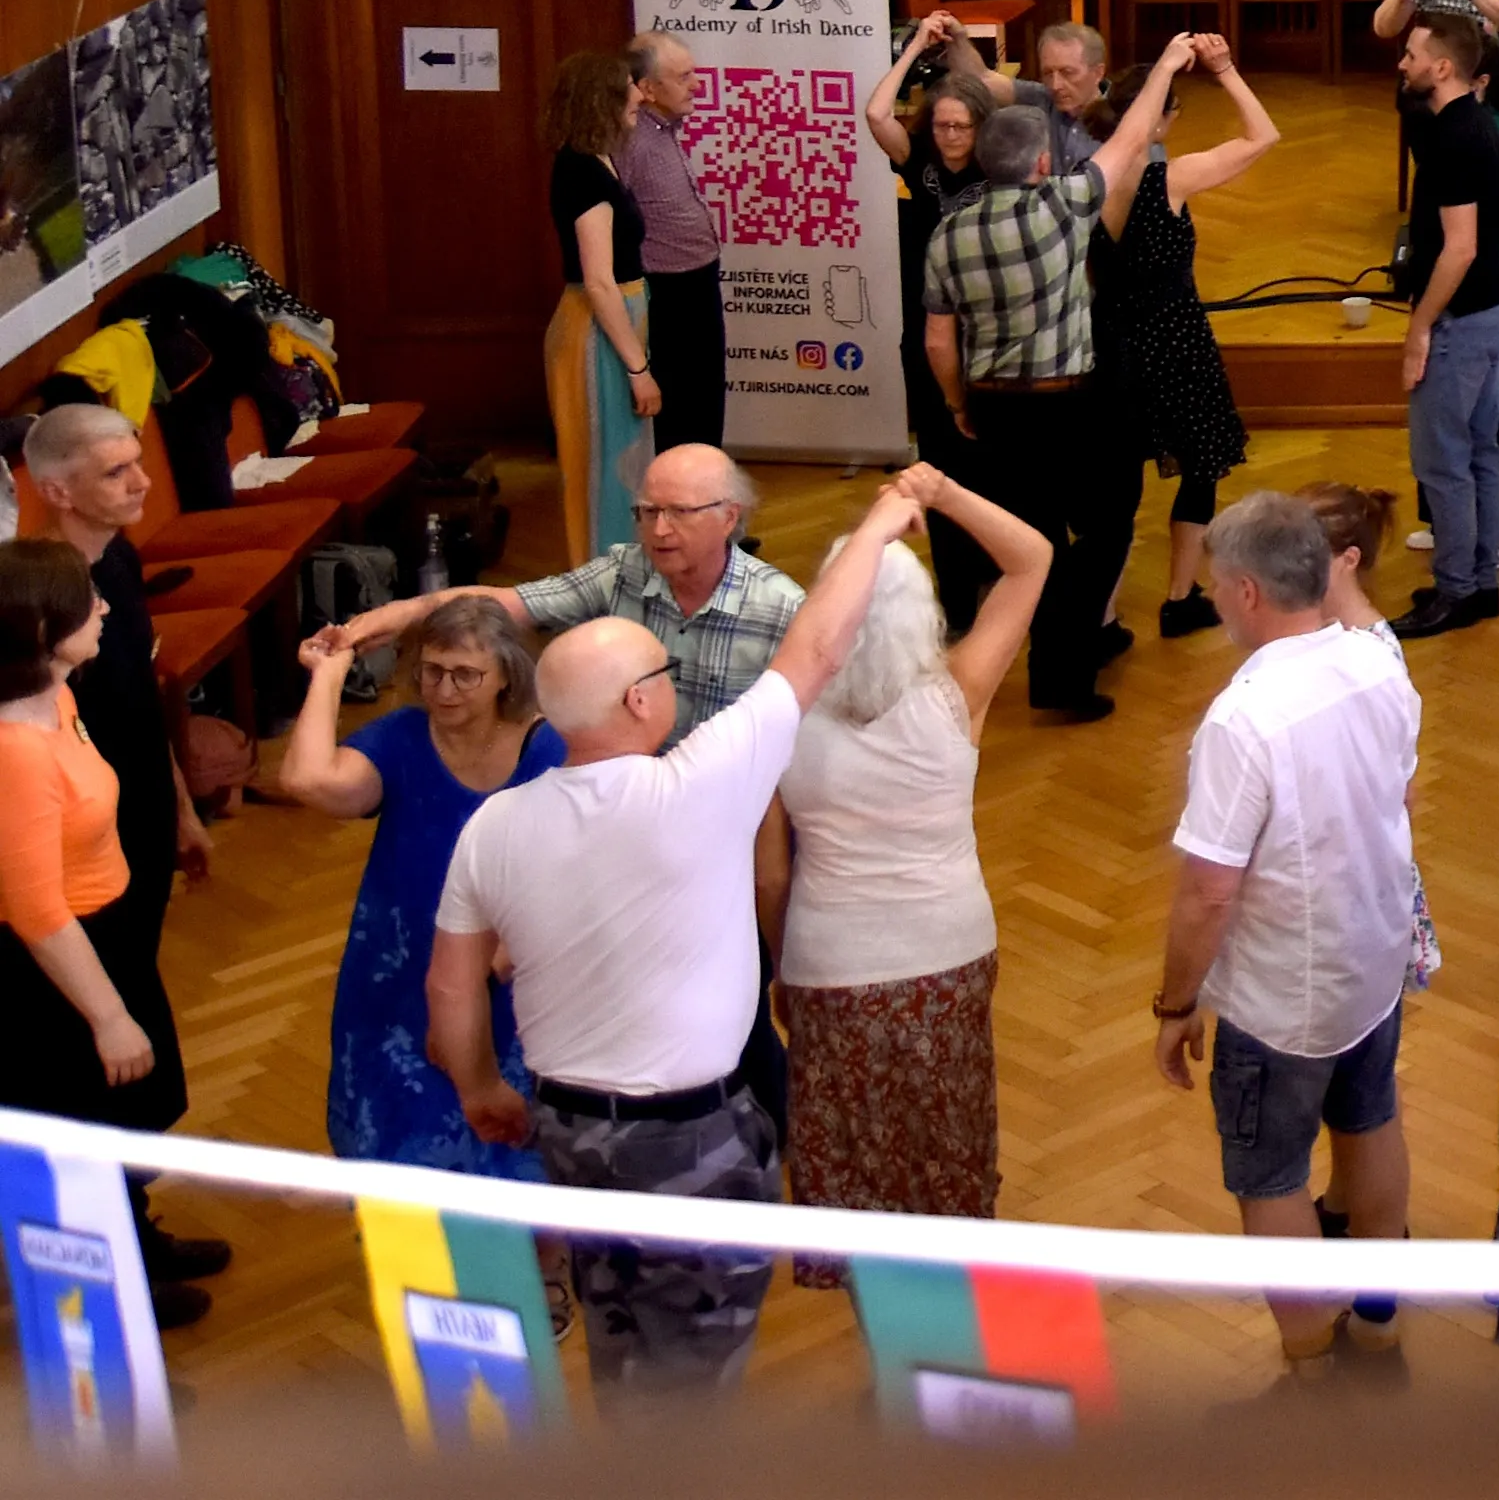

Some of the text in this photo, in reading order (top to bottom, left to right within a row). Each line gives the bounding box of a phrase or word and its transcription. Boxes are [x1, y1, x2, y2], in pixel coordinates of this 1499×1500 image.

[651, 15, 874, 37] Academy of Irish Dance
[779, 269, 808, 284] VÍCE
[734, 286, 810, 300] INFORMACÍ
[747, 303, 811, 315] KURZECH
[727, 346, 789, 361] UJTE NÁS
